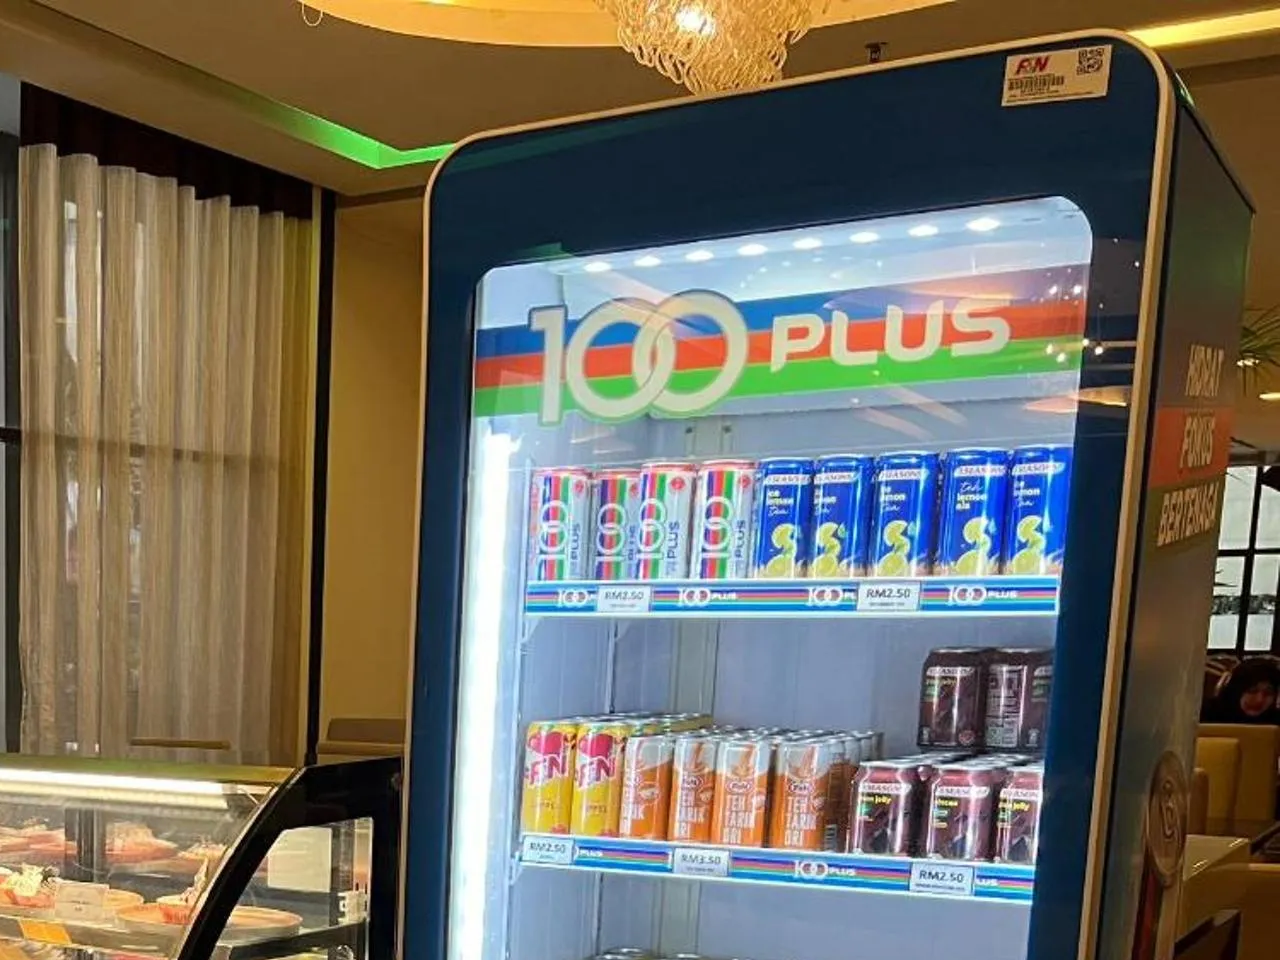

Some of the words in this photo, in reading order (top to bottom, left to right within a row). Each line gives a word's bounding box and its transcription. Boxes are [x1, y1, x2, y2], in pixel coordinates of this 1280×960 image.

[528, 289, 750, 425] 100
[770, 300, 1012, 373] PLUS
[866, 588, 911, 598] RM2.50
[919, 869, 964, 884] RM2.50
